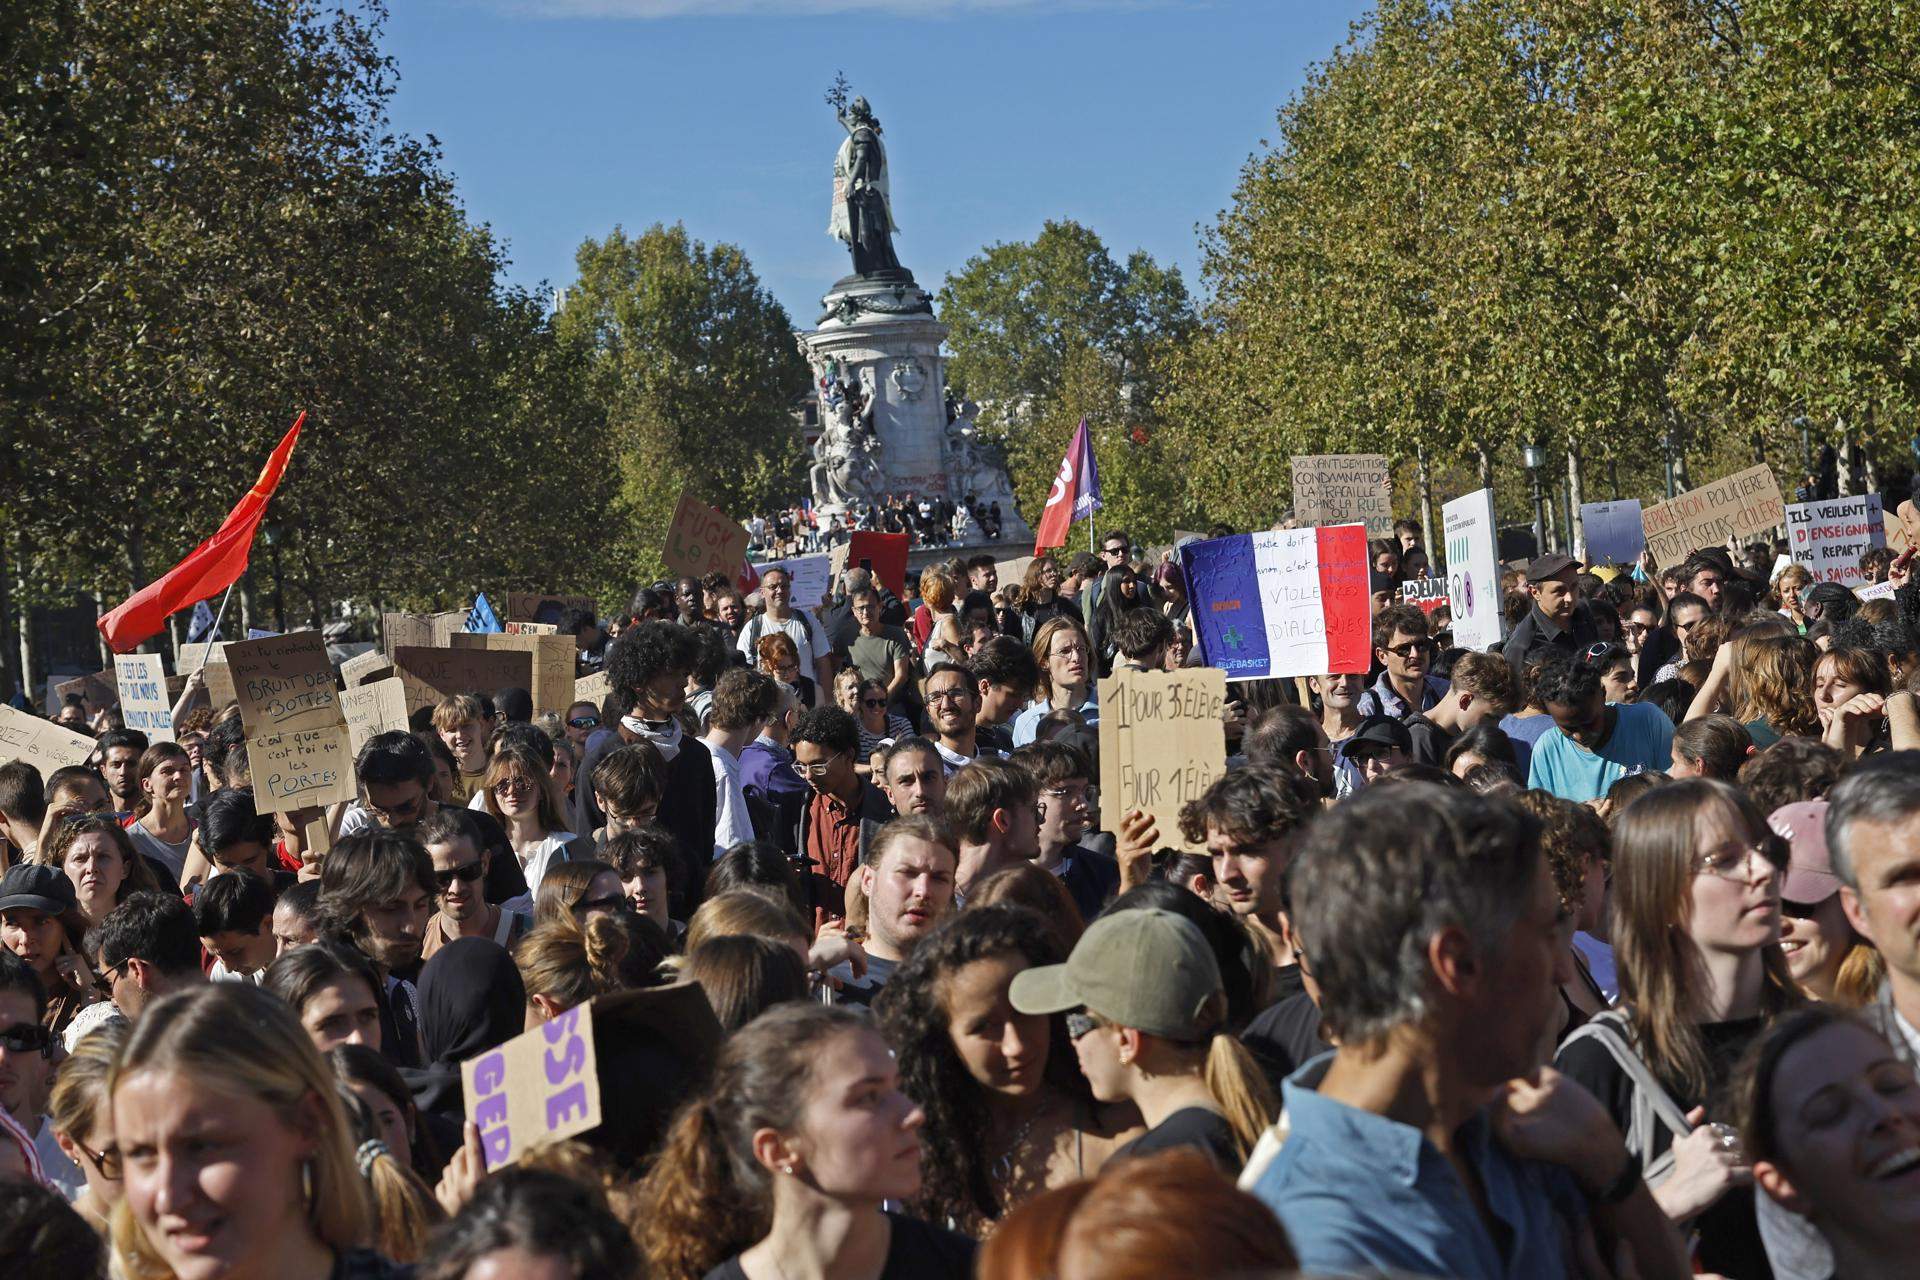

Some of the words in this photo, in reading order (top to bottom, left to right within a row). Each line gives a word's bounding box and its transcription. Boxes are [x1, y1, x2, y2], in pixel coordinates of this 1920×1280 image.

[1301, 487, 1315, 498] LA
[1308, 499, 1335, 510] DANS
[1340, 500, 1351, 510] LA
[1357, 498, 1385, 512] RUE
[1331, 508, 1349, 518] OU
[1788, 509, 1813, 524] ILS
[1817, 504, 1867, 520] VEULENT
[1286, 535, 1309, 548] doit
[1795, 549, 1815, 562] PAS
[1404, 584, 1418, 596] LA
[246, 673, 300, 703] BRUIT
[304, 671, 333, 688] DES
[266, 691, 333, 717] BOTTES
[1107, 682, 1130, 729] 1
[1130, 688, 1163, 722] POUR
[1167, 682, 1182, 720] 35
[294, 731, 320, 746] que
[268, 748, 293, 760] c'est
[323, 741, 338, 753] qui
[289, 761, 308, 771] les
[268, 770, 338, 797] PORTES
